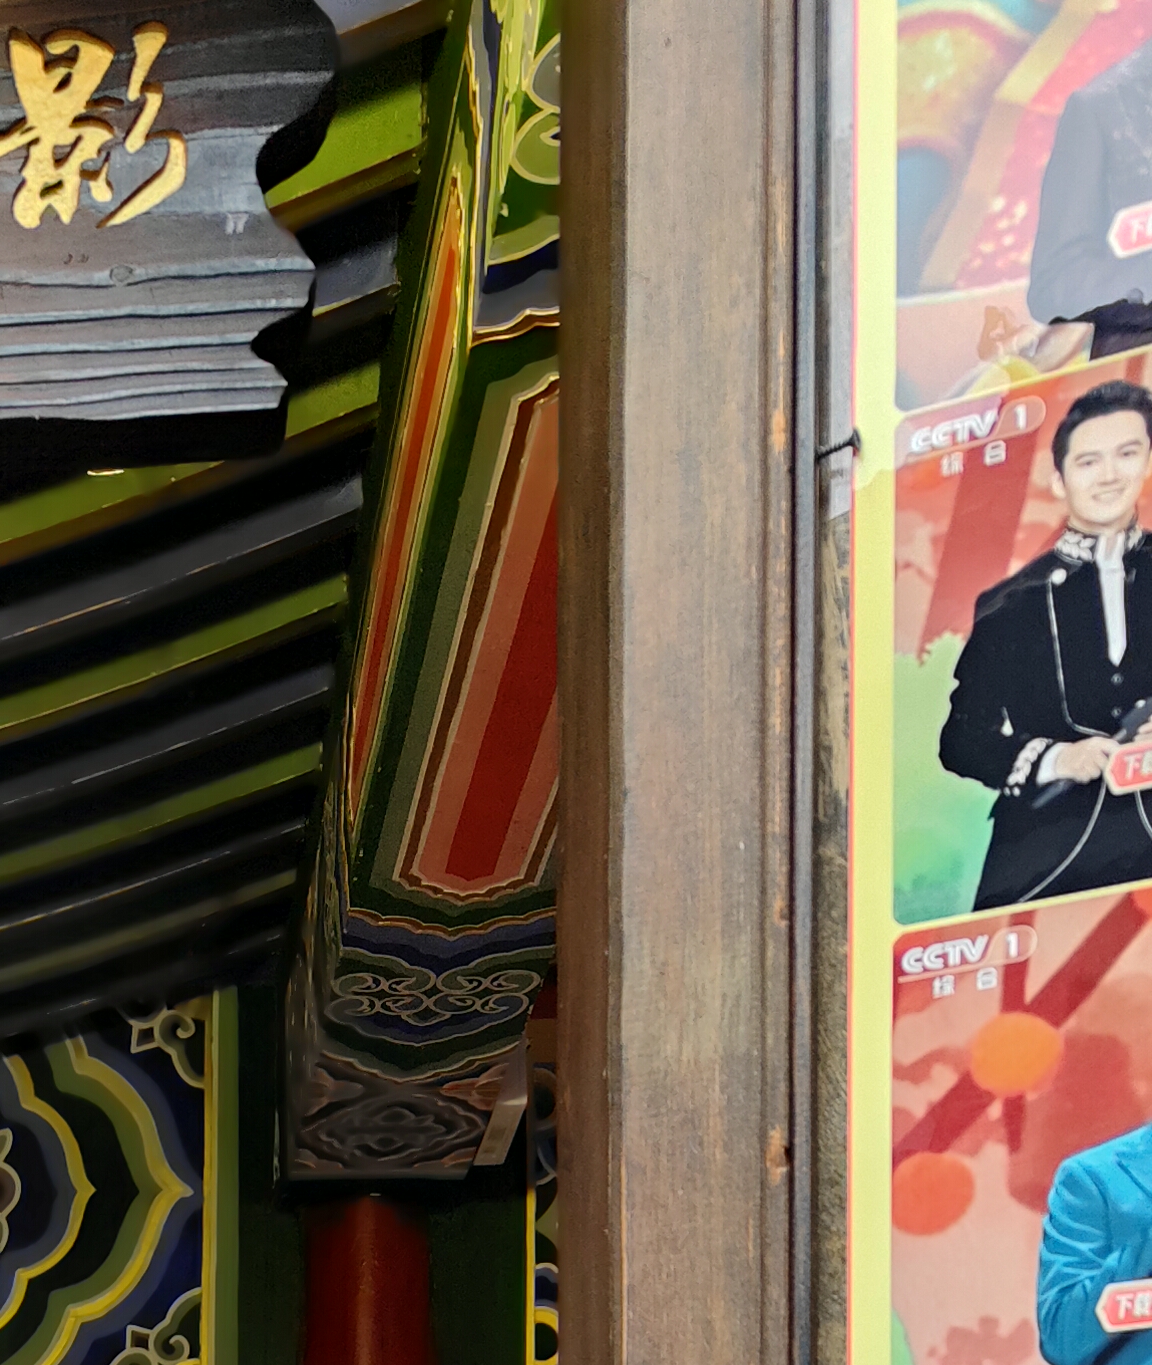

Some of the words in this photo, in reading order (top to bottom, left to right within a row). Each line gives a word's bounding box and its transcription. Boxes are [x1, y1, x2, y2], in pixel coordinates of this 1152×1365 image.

[910, 408, 998, 453] CCTV
[1013, 403, 1027, 430] 1
[901, 934, 989, 974] CCTV
[1006, 932, 1018, 958] 1
